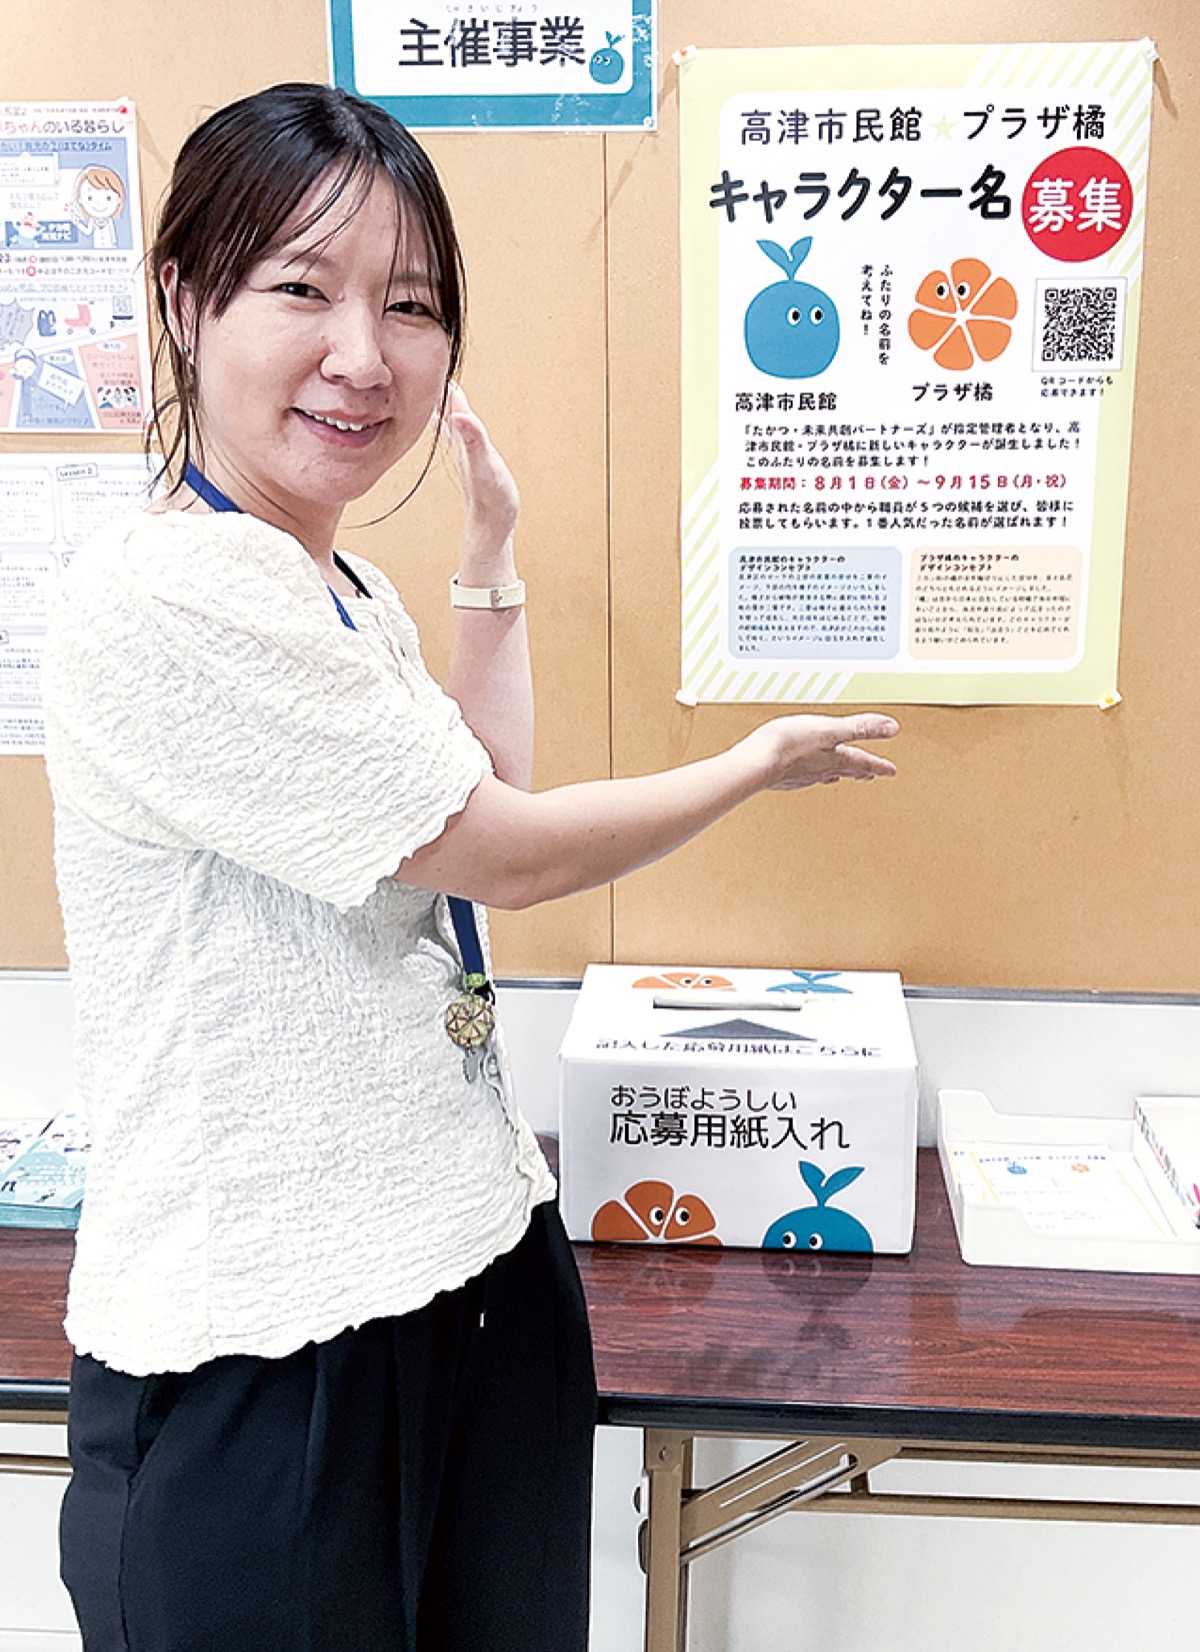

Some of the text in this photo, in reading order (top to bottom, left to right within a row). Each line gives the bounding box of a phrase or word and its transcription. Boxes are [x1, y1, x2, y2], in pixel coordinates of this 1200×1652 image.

[399, 16, 590, 69] 主催事業
[741, 104, 1105, 145] 高津市民館 プラザ橘
[709, 164, 1123, 232] キャラクター名 募集
[861, 265, 873, 335] 考えてね！
[879, 265, 893, 365] ふたりの名前を
[736, 392, 836, 412] 高津市民館
[913, 382, 992, 401] プラザ橘
[611, 1085, 797, 1112] おうぼようしい
[610, 1110, 850, 1150] 応募用紙入れ
